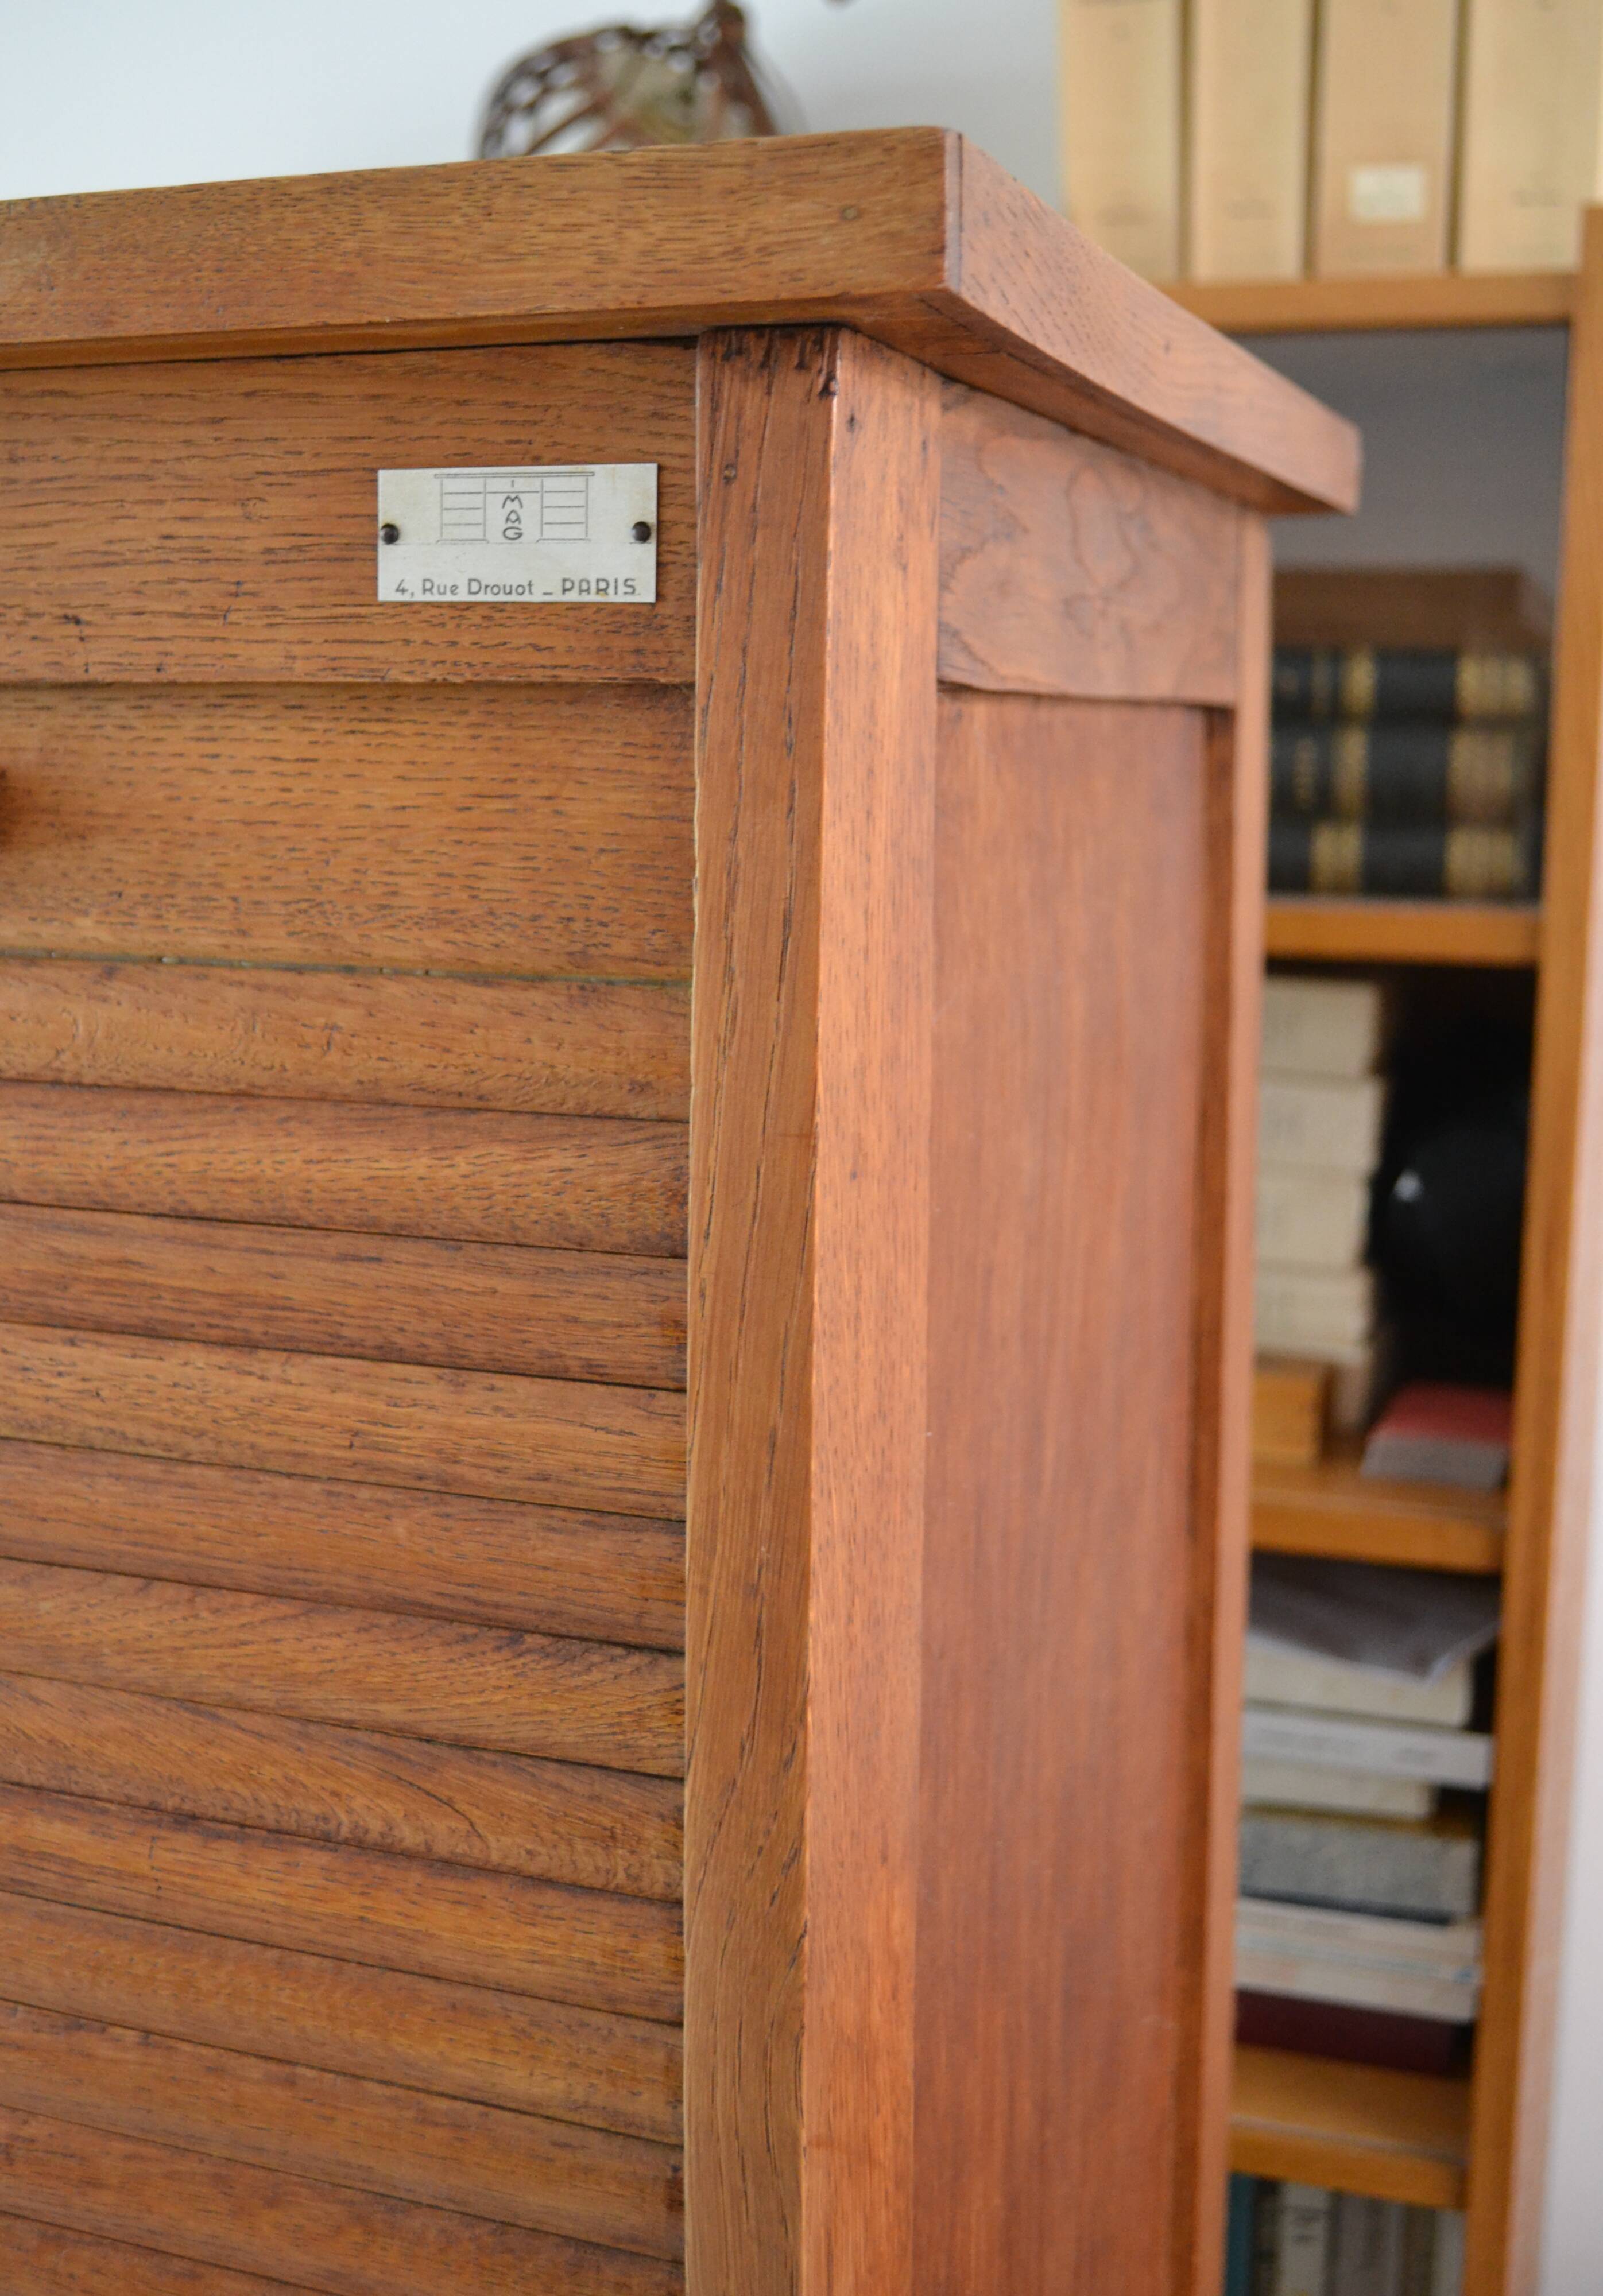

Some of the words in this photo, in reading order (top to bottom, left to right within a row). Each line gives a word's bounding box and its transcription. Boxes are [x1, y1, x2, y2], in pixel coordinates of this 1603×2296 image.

[394, 578, 415, 599] 4,
[421, 577, 459, 596] Rue
[467, 577, 535, 596] Drouot
